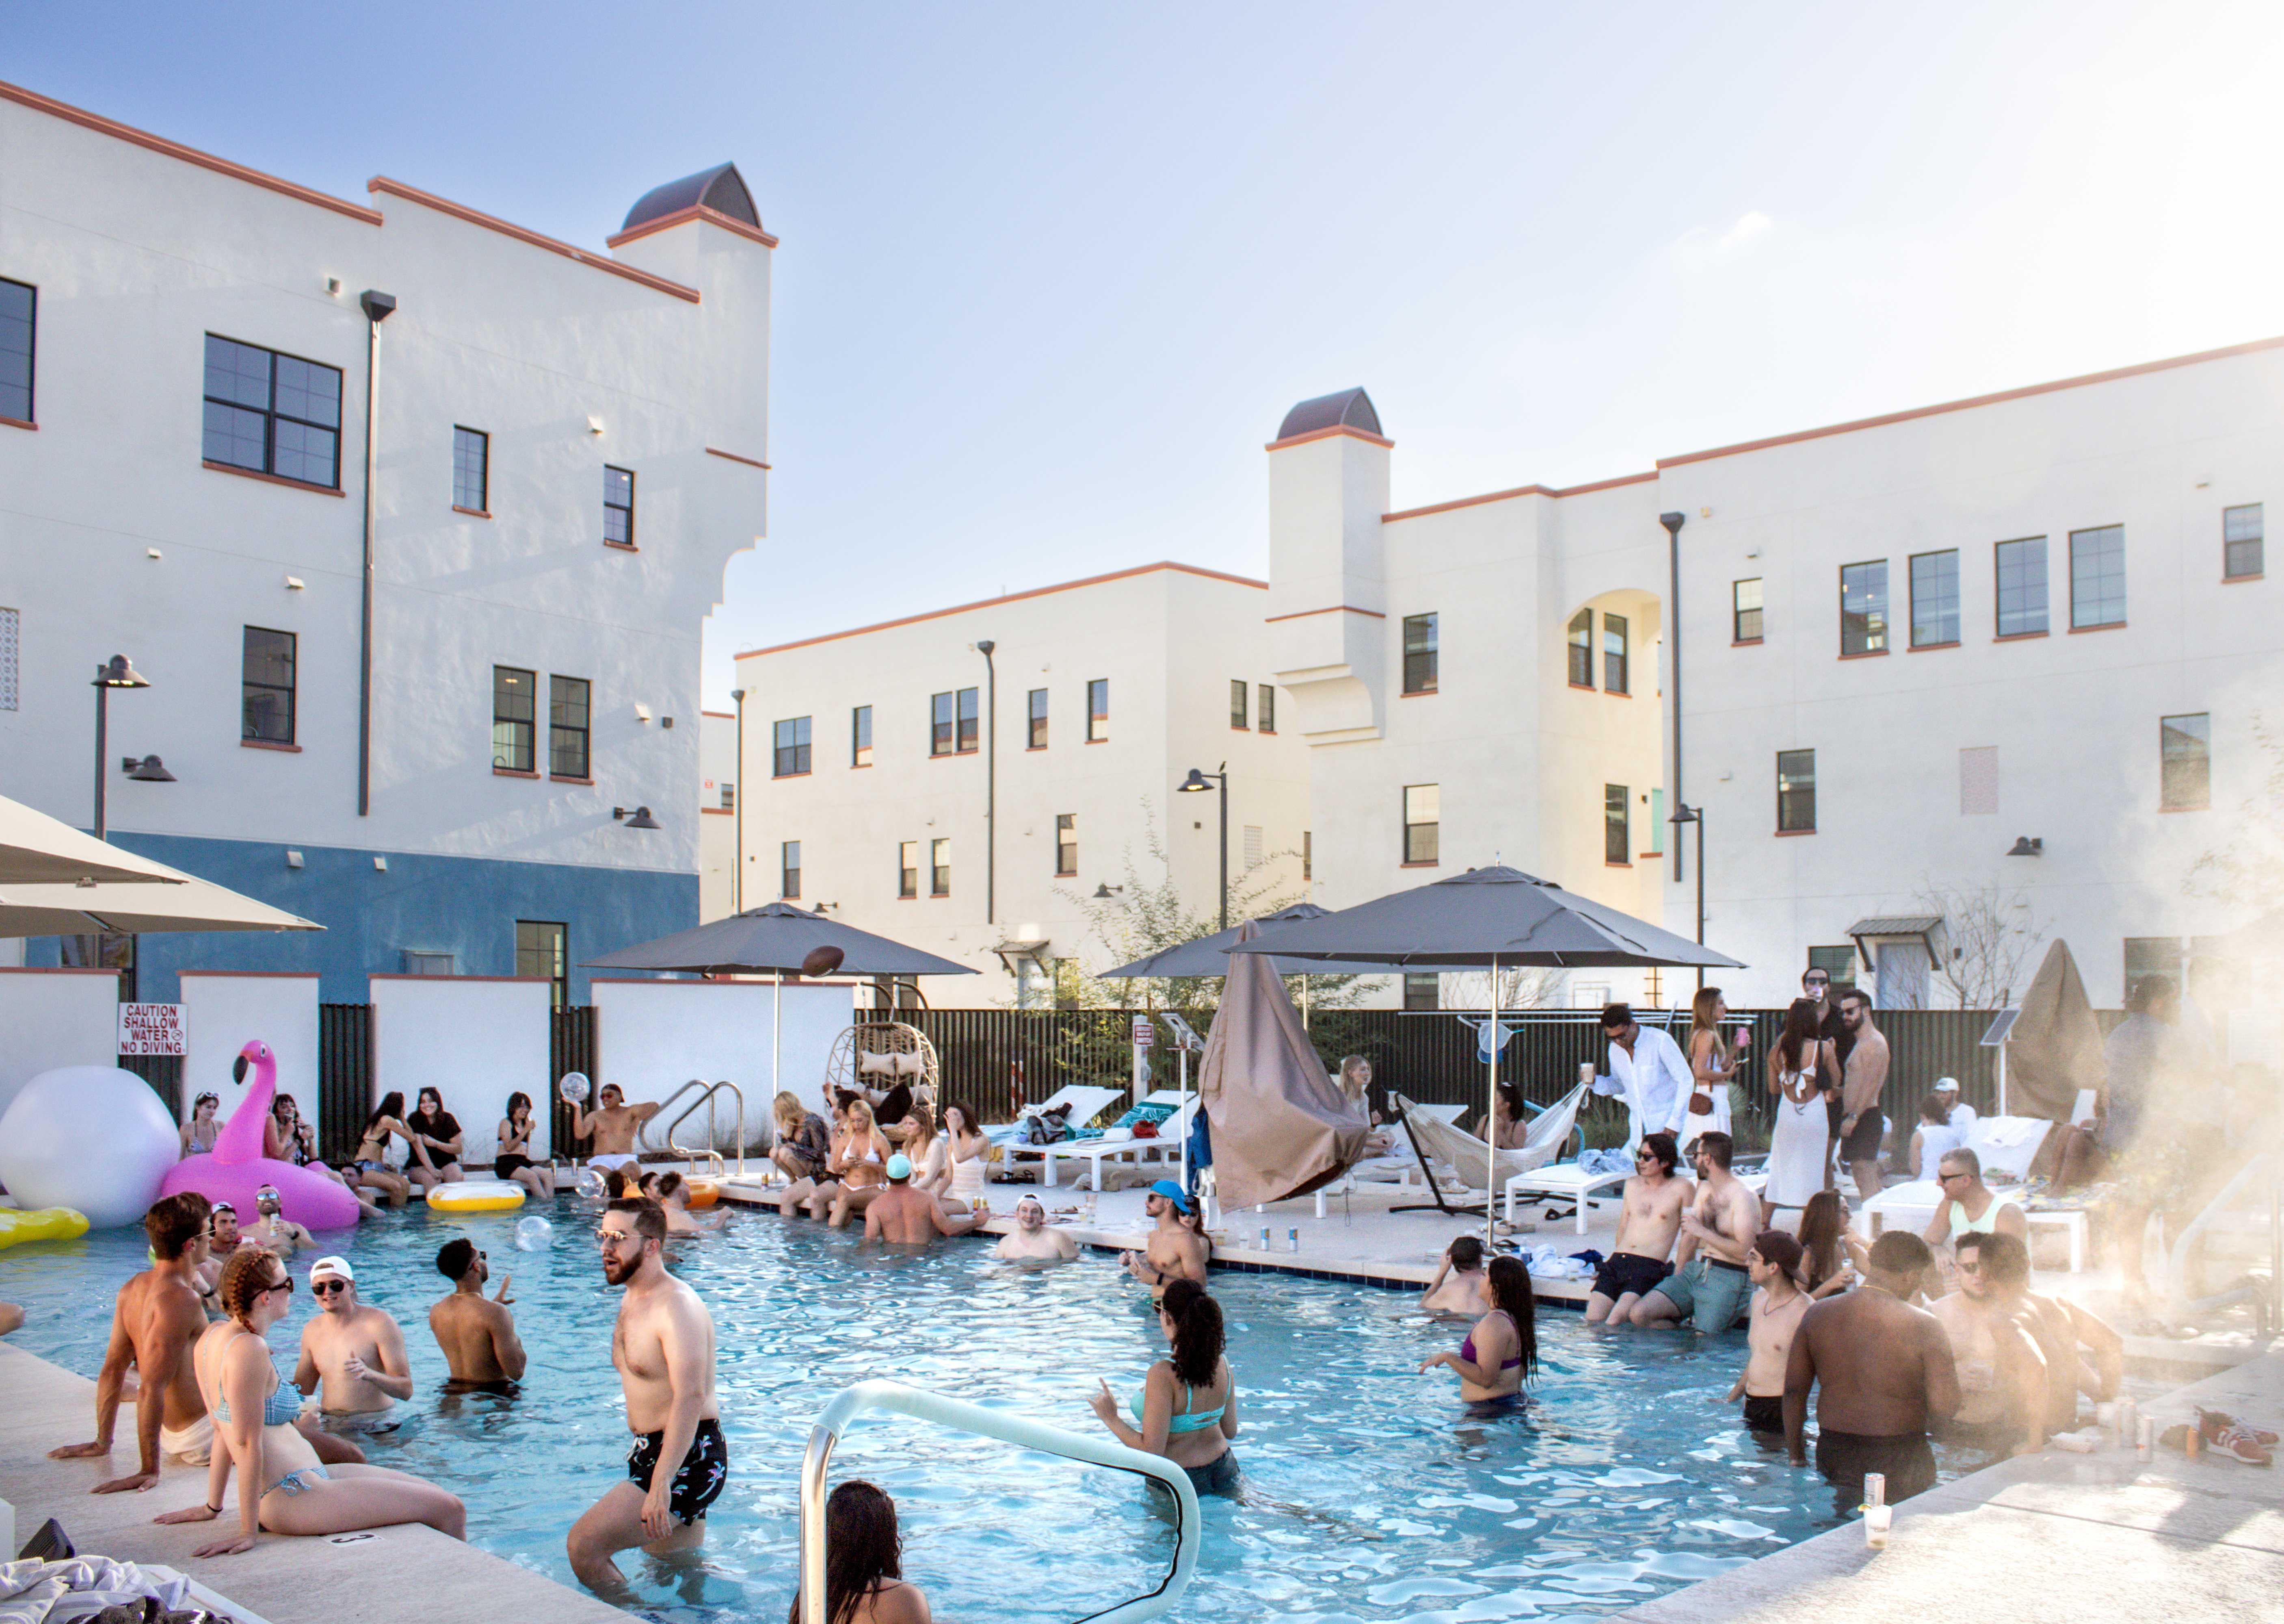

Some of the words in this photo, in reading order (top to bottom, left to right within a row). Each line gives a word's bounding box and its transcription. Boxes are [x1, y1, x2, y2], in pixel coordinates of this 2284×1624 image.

[127, 1005, 177, 1017] CAUTION
[124, 1017, 178, 1028] SHALLOW
[131, 1030, 168, 1041] WATER
[121, 1042, 136, 1053] NO
[142, 1042, 181, 1053] DIVING
[331, 1534, 374, 1543] 3
